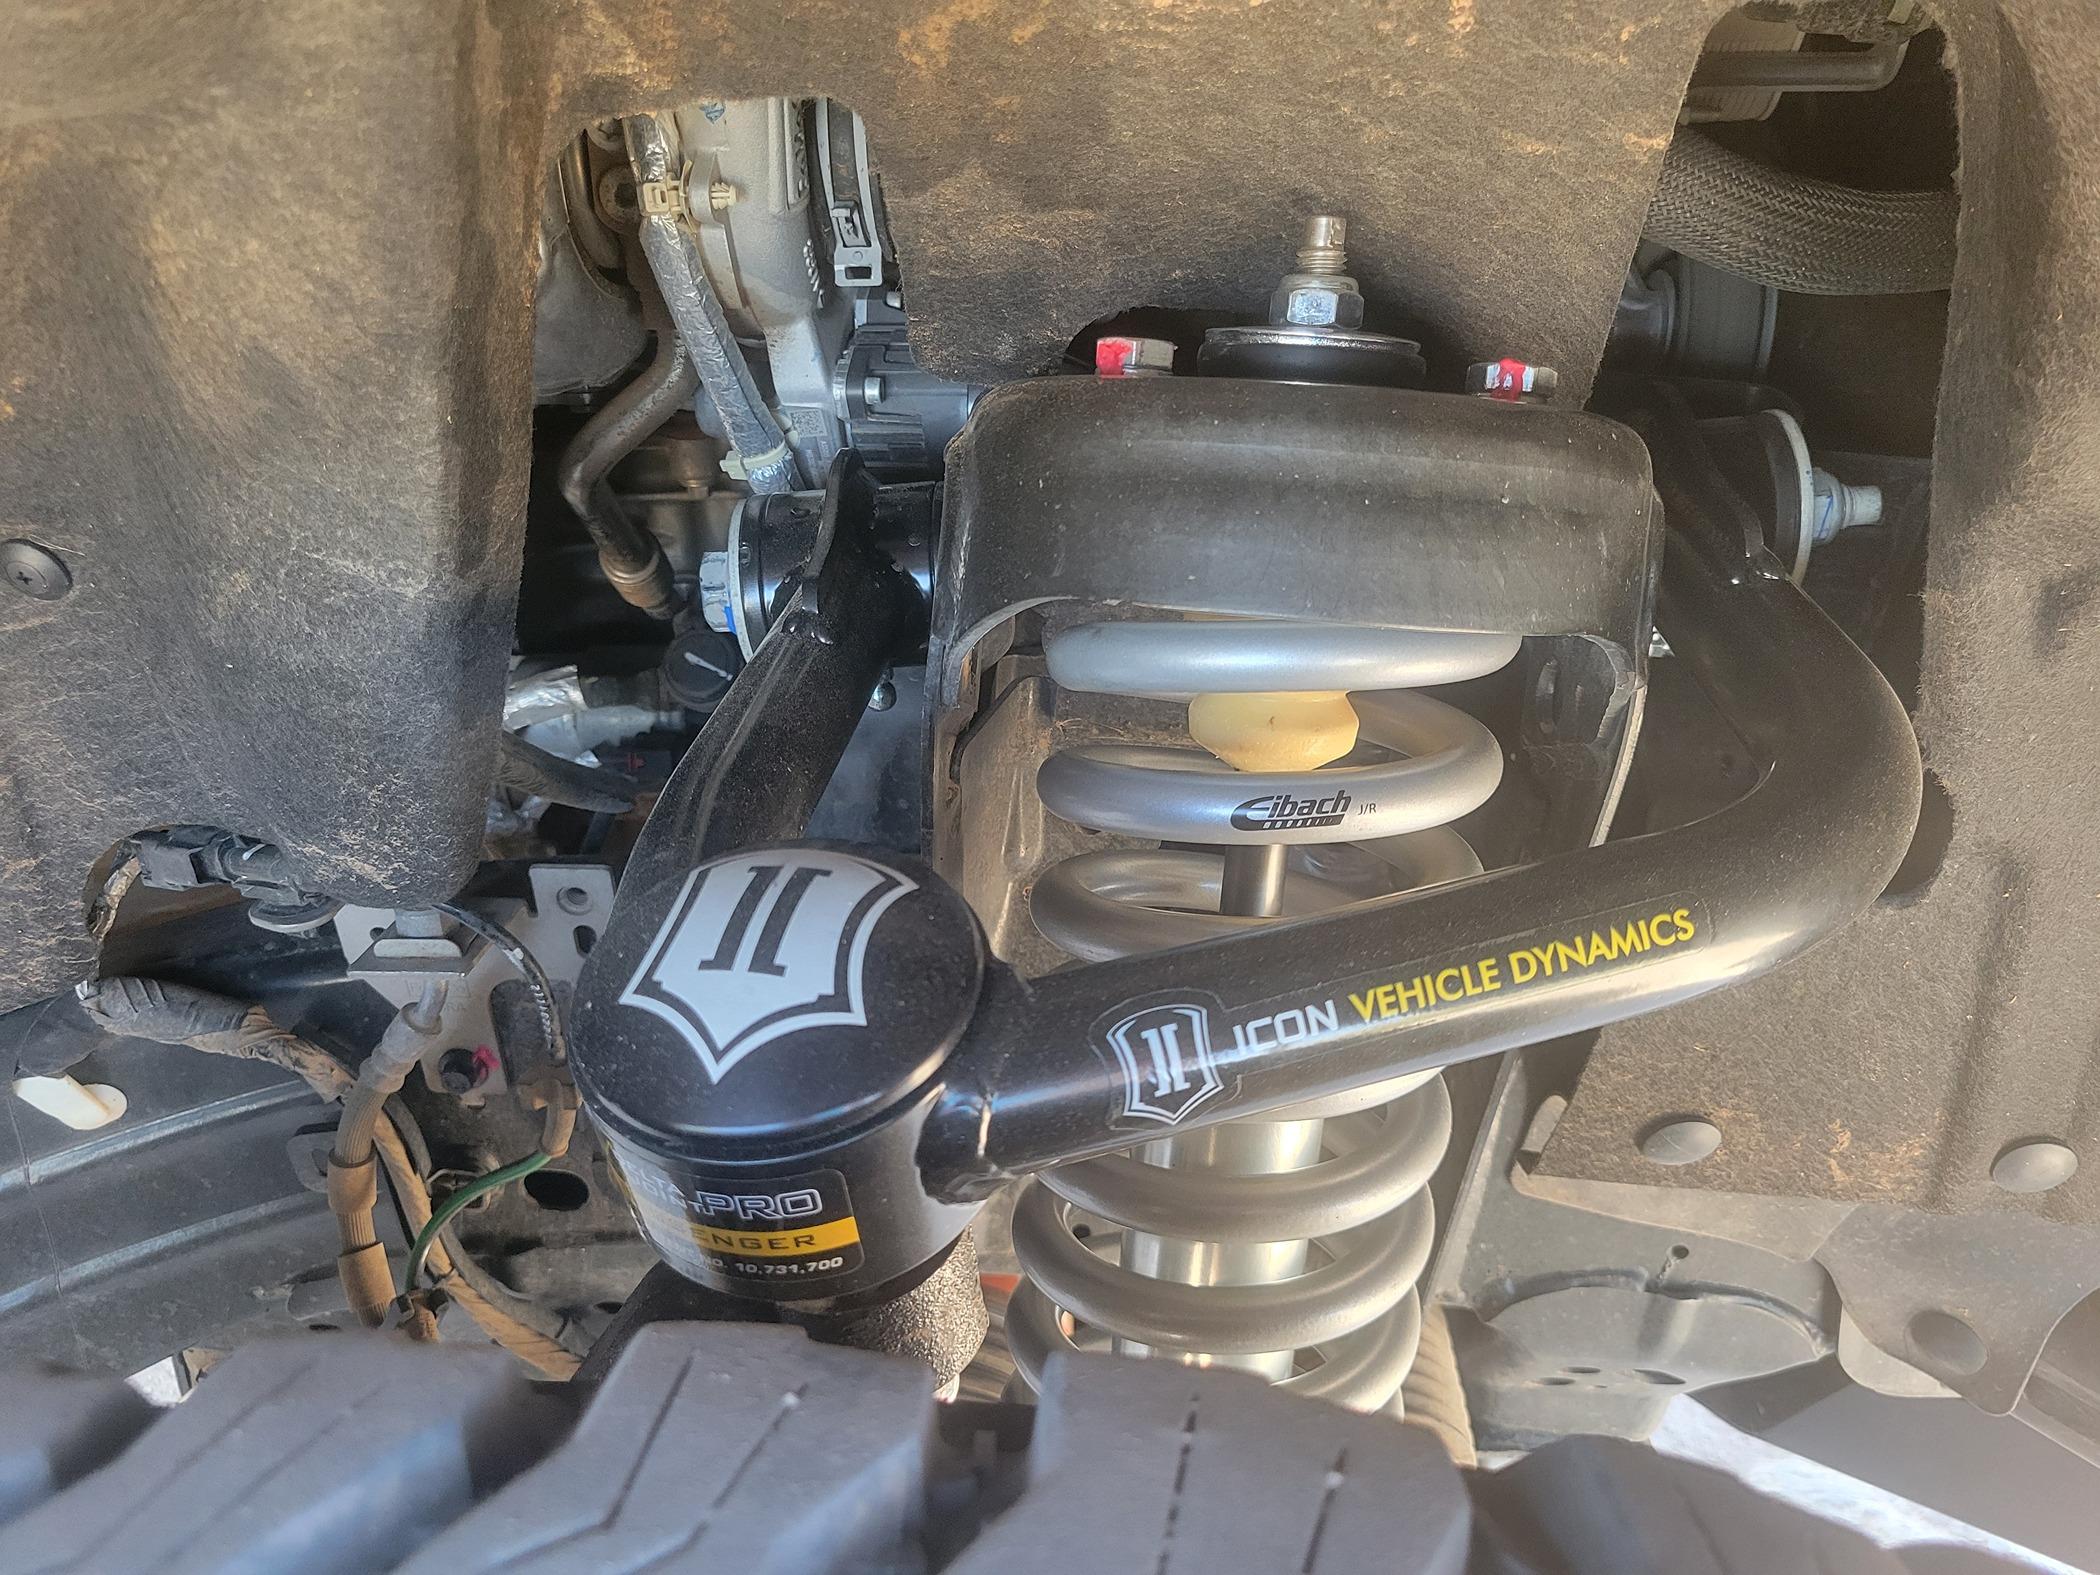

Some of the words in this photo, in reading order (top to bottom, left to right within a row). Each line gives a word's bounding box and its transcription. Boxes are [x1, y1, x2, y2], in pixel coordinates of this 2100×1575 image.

[1230, 789, 1352, 831] Eibach
[1357, 802, 1377, 816] J/R
[1231, 999, 1340, 1055] ICON
[1347, 957, 1502, 1024] VEHICLE
[1507, 908, 1695, 986] DYNAMICS
